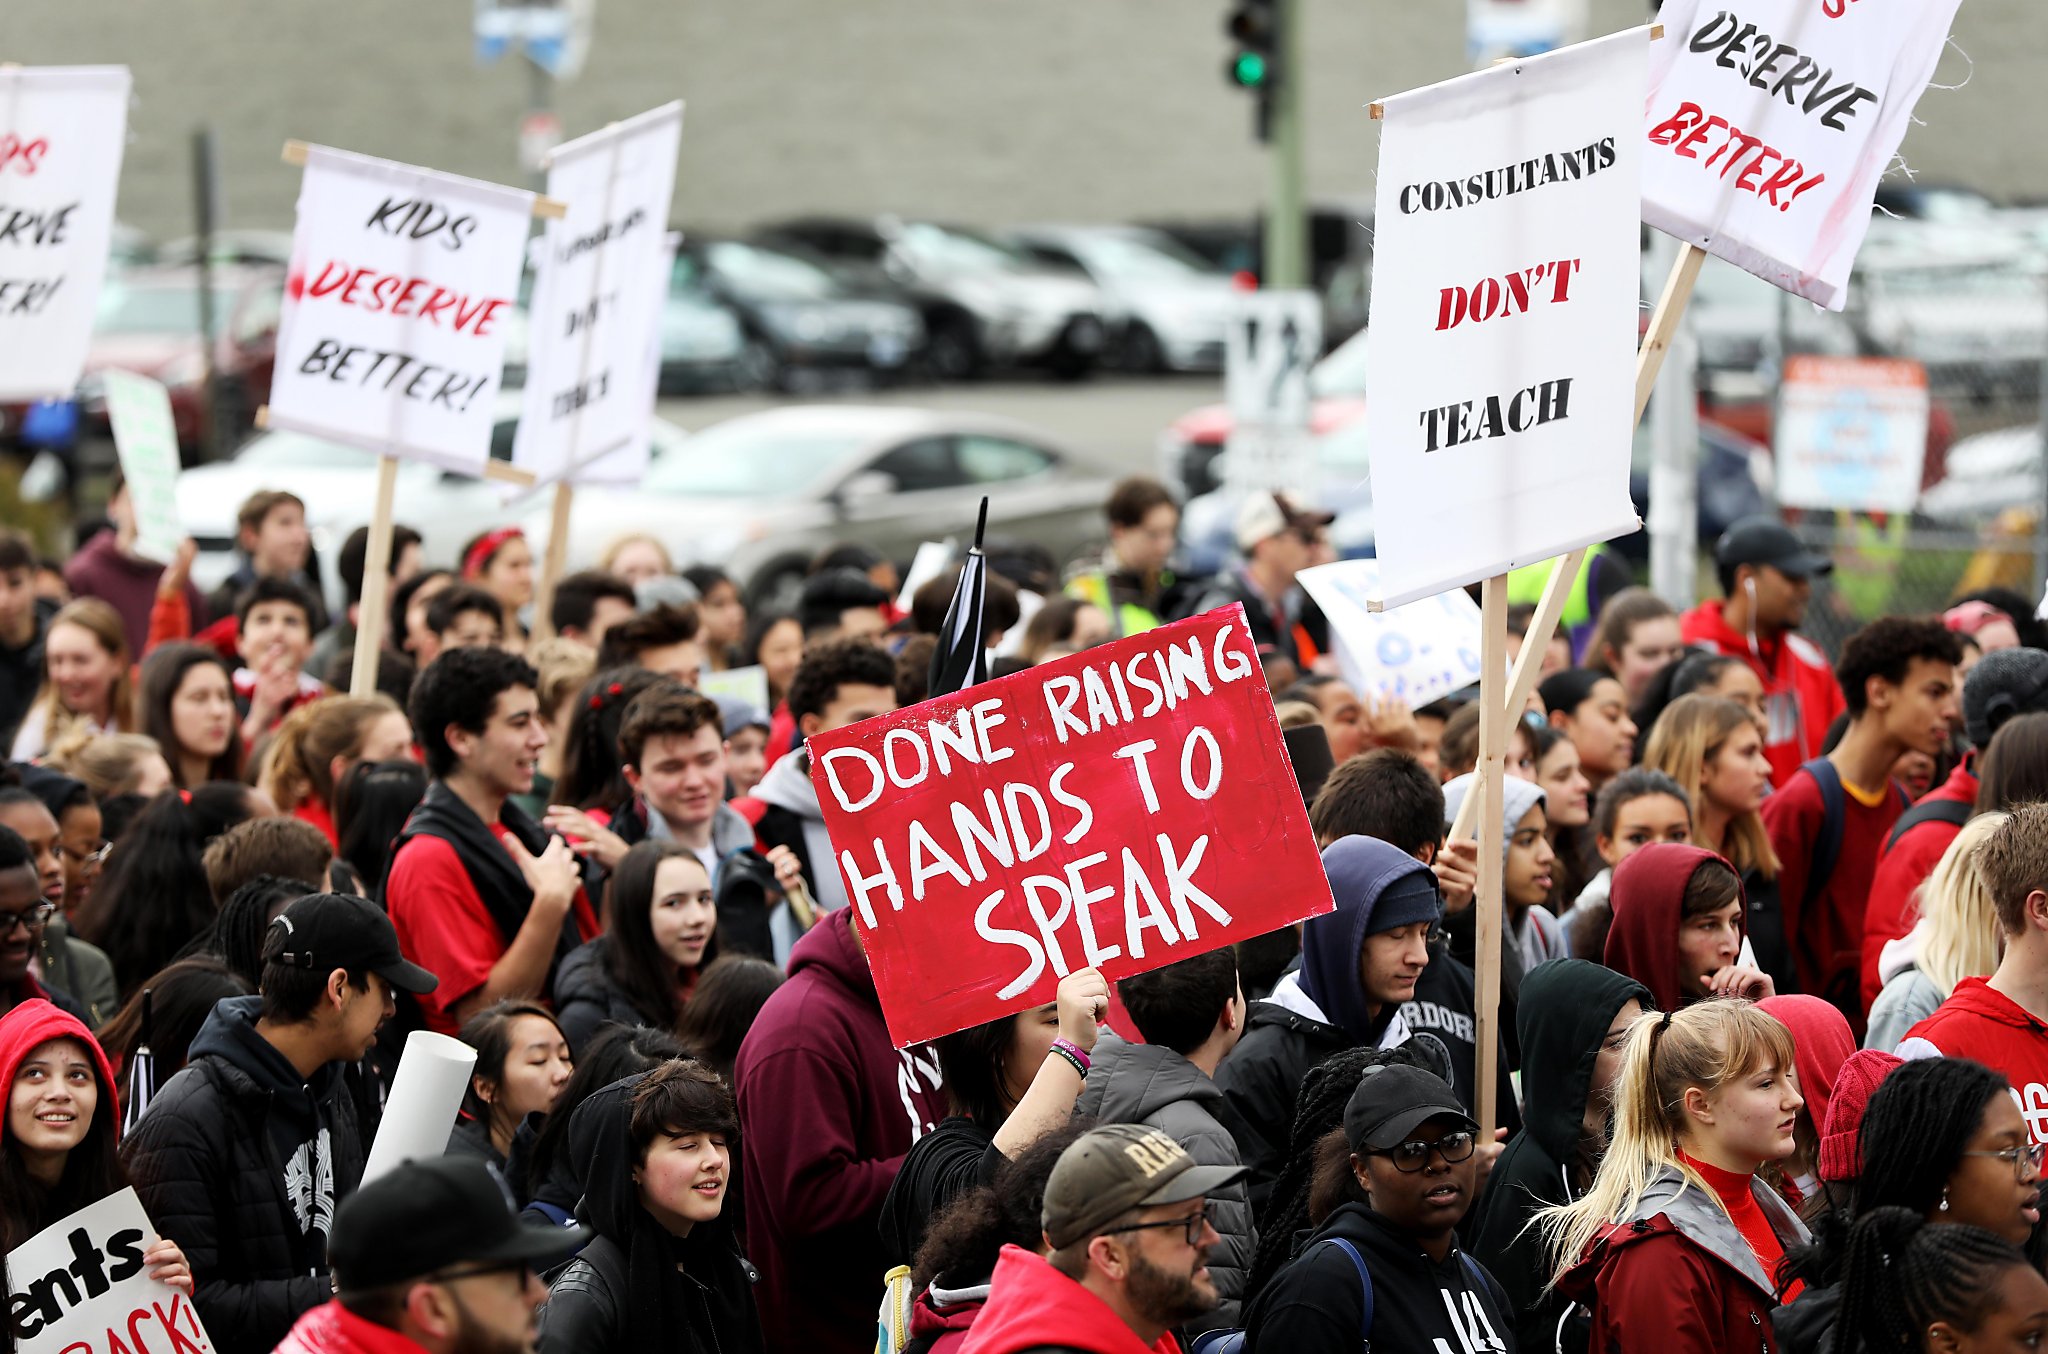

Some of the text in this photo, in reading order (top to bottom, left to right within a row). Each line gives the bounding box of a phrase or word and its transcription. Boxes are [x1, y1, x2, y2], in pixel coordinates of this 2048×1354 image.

[1689, 10, 1878, 132] DESERVE
[1399, 136, 1616, 215] CONSULTANTS
[1648, 101, 1825, 212] BETTER!
[366, 196, 477, 250] KIDS
[308, 260, 510, 337] DESERVE
[1434, 258, 1581, 331] DON'T
[299, 338, 488, 413] BETTER!
[1419, 377, 1574, 453] TEACH
[820, 698, 1015, 813] DONE
[1043, 624, 1253, 745] RAISING
[840, 725, 1224, 930] HANDS TO
[974, 832, 1232, 1000] SPEAK
